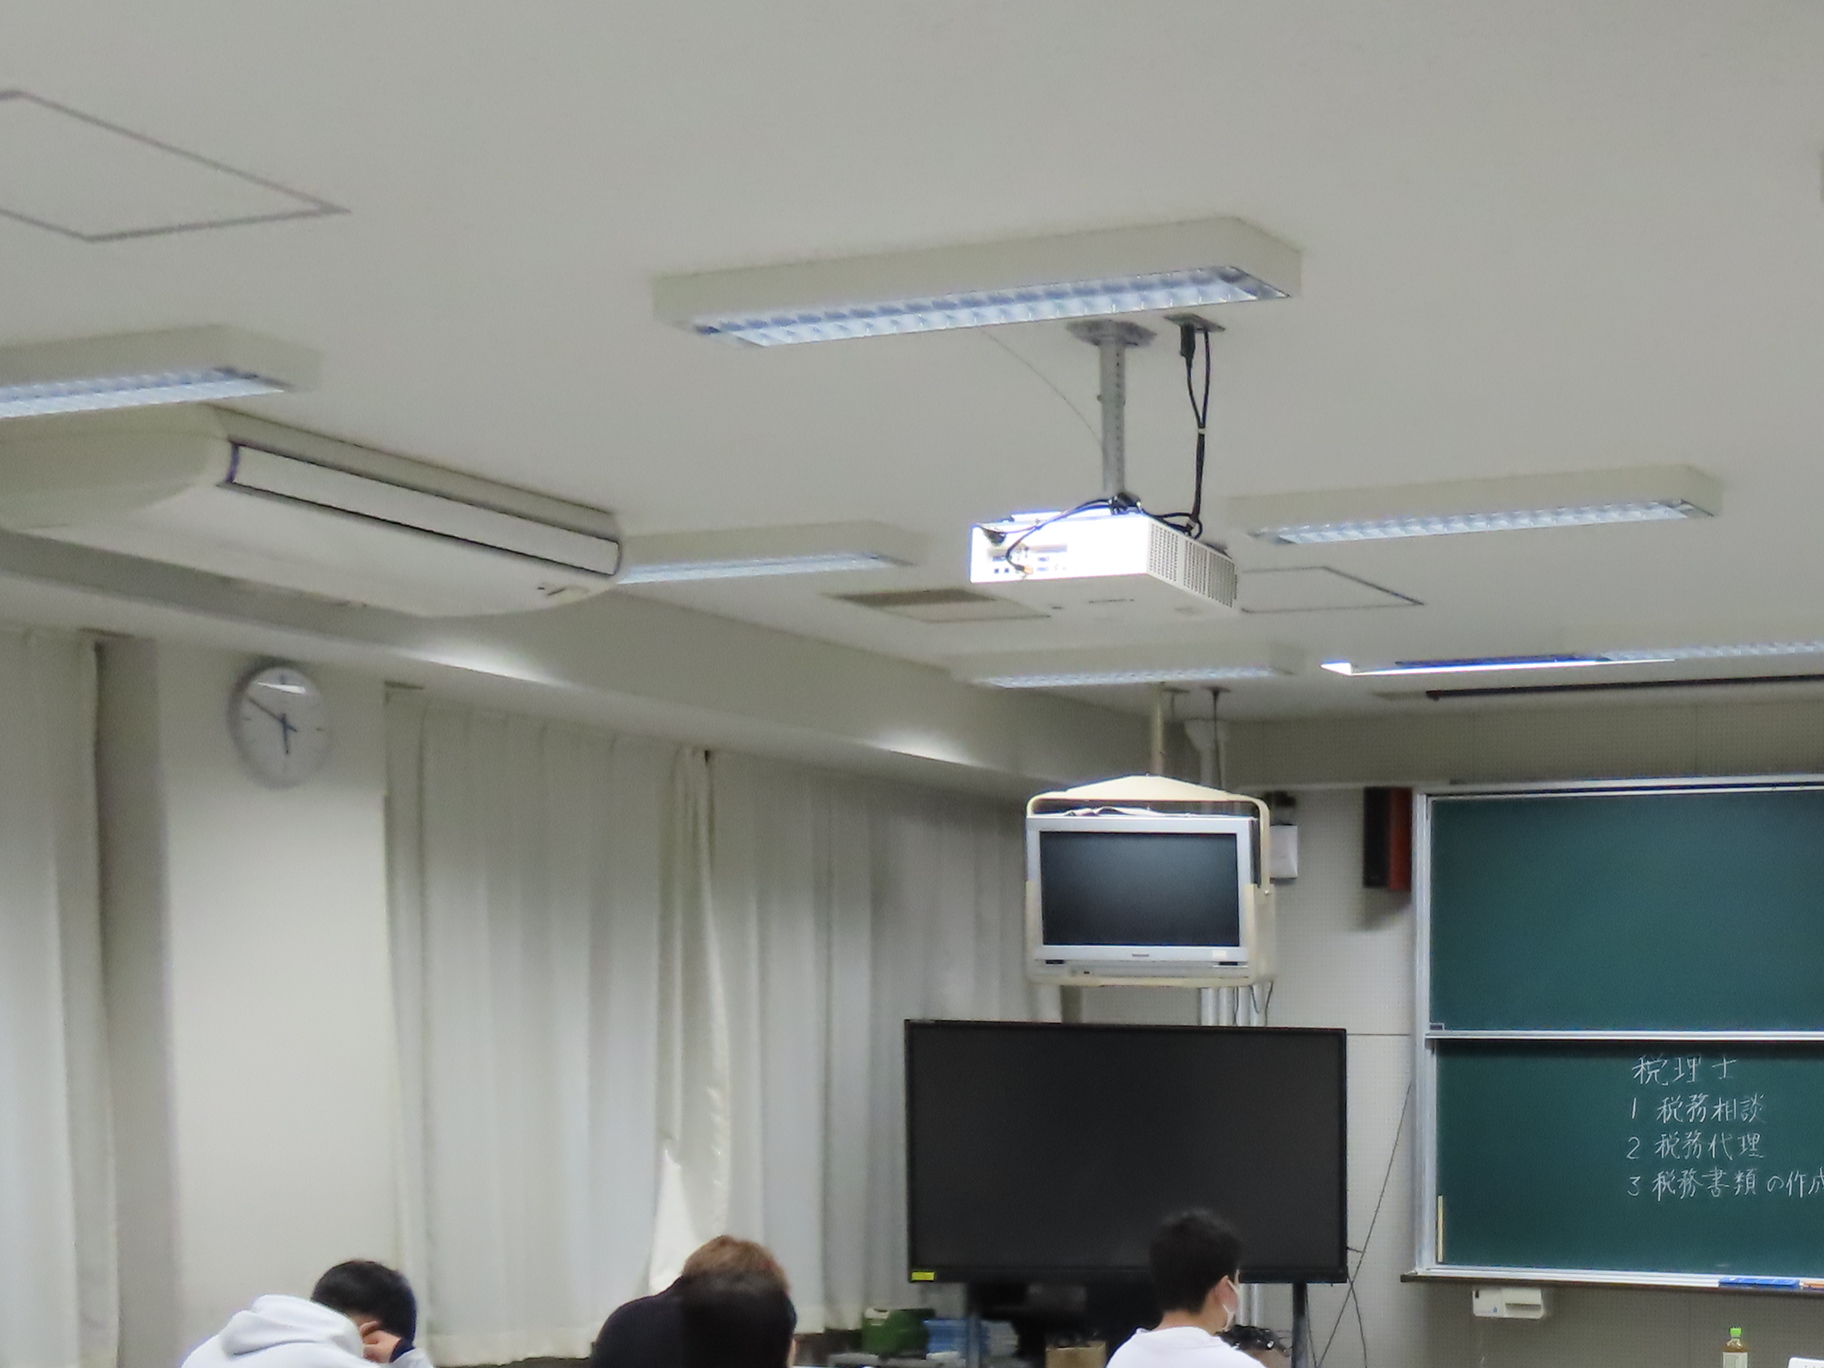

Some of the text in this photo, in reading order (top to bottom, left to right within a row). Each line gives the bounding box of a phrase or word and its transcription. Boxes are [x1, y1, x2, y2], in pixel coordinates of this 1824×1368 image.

[1631, 1053, 1738, 1086] 税理士
[1631, 1093, 1766, 1124] 1 税務相談
[1626, 1131, 1764, 1161] 2 税務代理
[1627, 1176, 1641, 1197] 3
